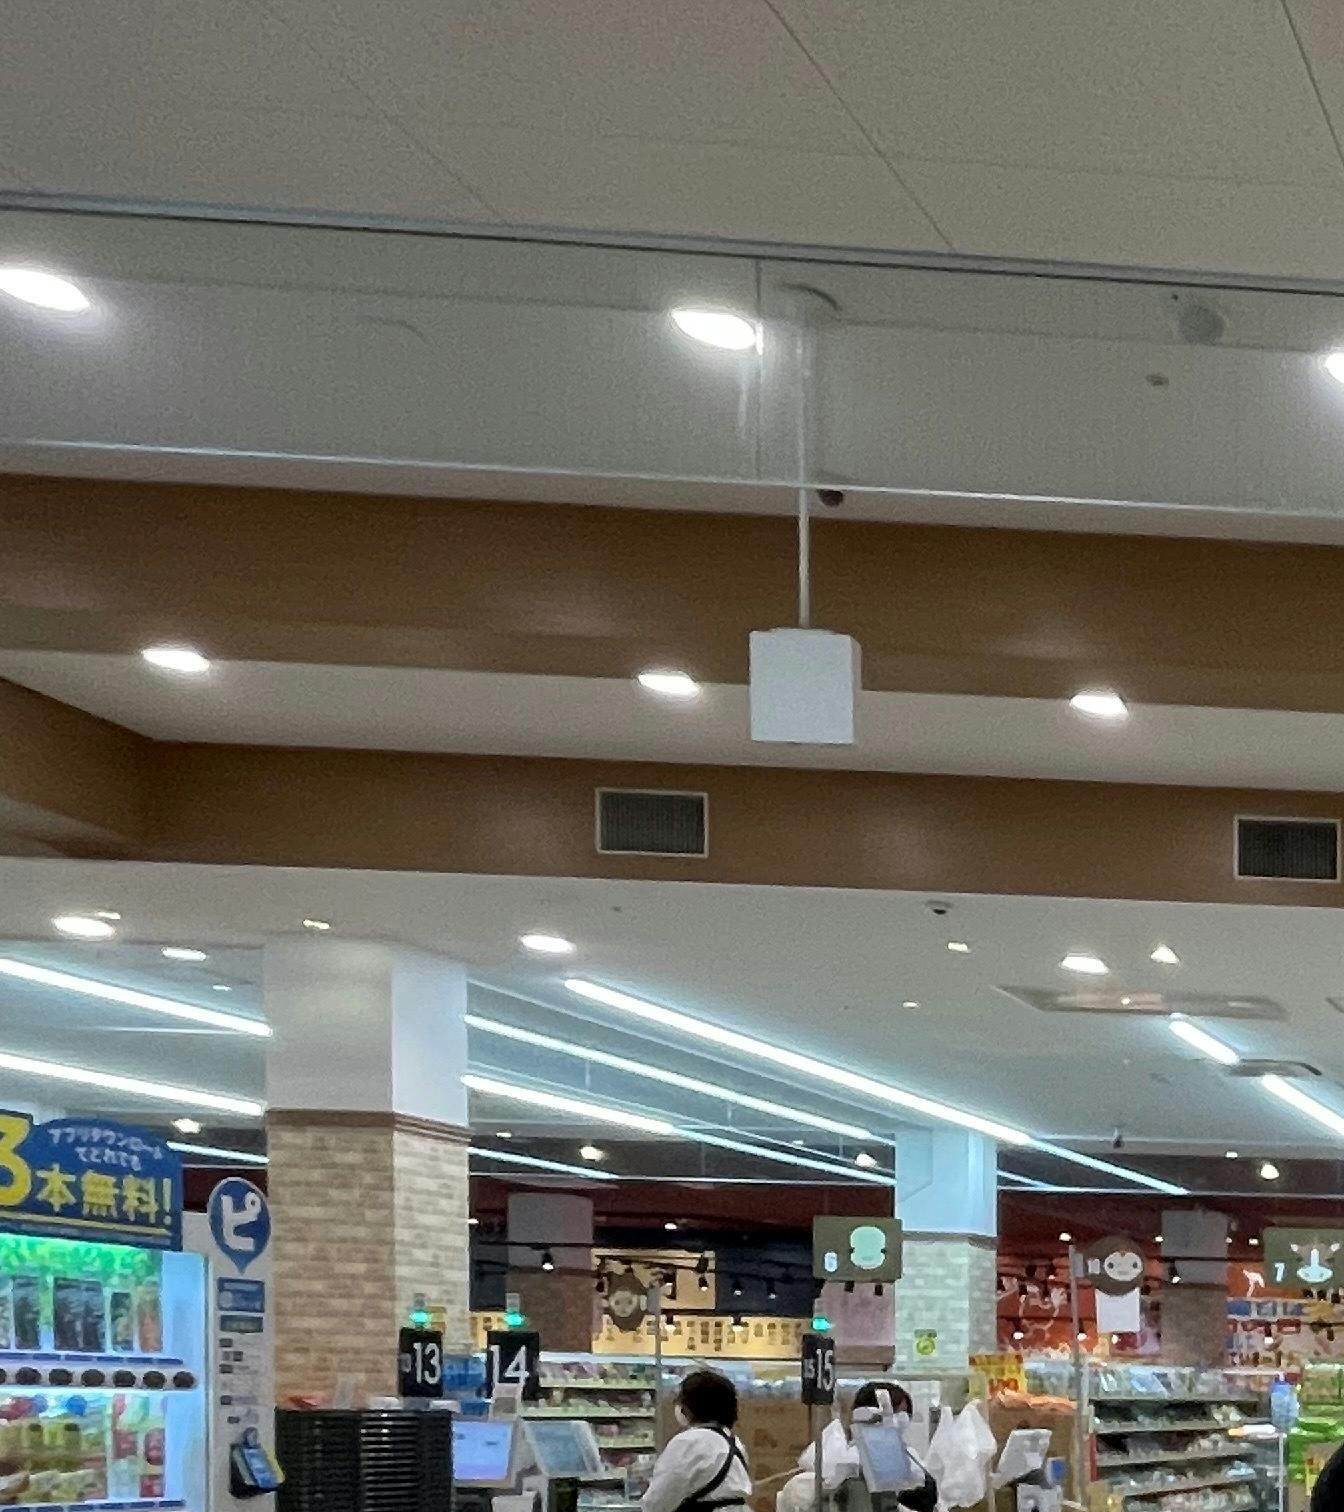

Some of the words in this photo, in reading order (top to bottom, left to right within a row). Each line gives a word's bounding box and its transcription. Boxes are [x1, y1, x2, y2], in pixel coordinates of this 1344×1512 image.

[412, 1342, 441, 1385] 13
[489, 1344, 530, 1388] 14
[816, 1348, 834, 1392] 15
